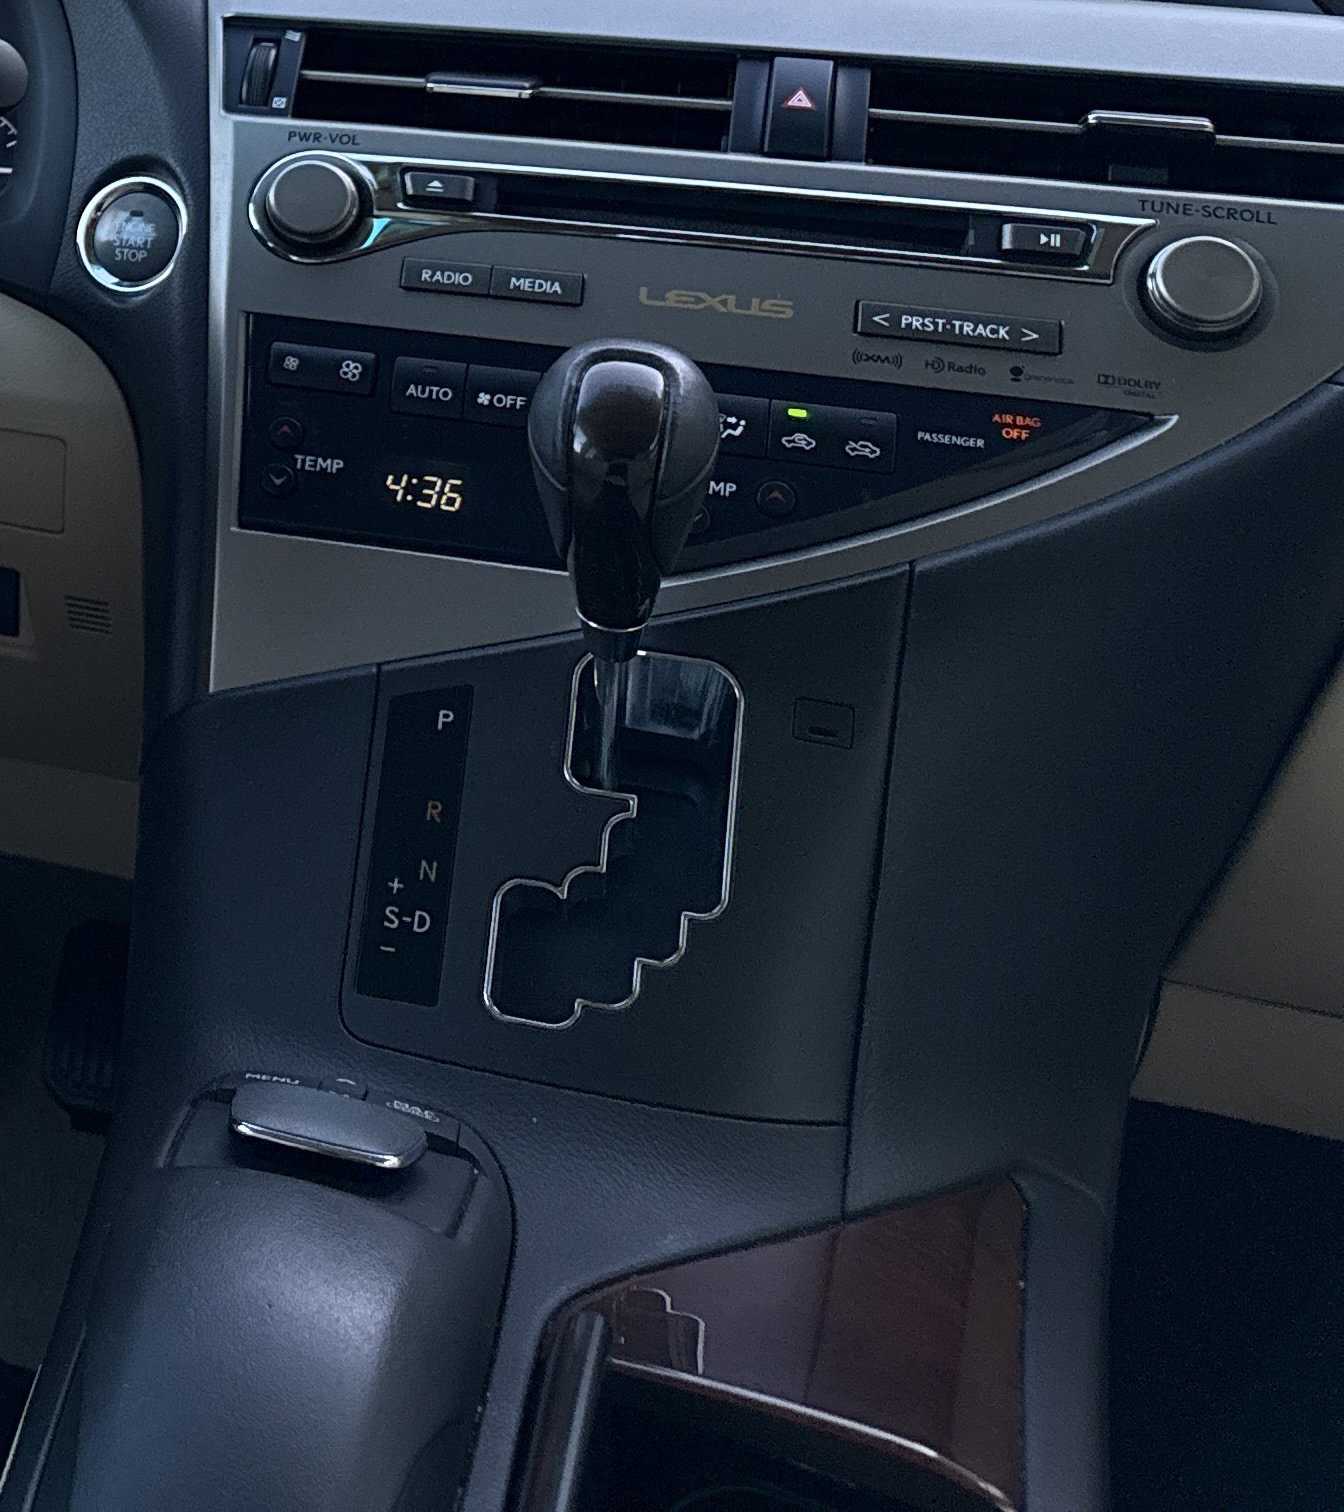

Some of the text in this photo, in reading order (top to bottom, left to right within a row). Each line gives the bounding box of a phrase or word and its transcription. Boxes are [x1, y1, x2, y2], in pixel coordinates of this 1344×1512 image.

[113, 237, 152, 248] START
[114, 248, 148, 263] STOP
[421, 269, 473, 286] RADIO
[509, 276, 562, 295] MEDIA
[639, 286, 794, 319] LEXUS
[948, 361, 987, 377] Radio
[1116, 375, 1162, 391] DOLBY
[405, 384, 528, 410] AUTO OFF
[992, 413, 1042, 428] AIR BAG
[916, 431, 985, 449] PASSENGER
[1002, 428, 1031, 441] OFF
[293, 454, 344, 474] TEMP
[385, 473, 463, 512] 4:36
[437, 709, 454, 731] P
[426, 800, 443, 823] R
[419, 859, 438, 883] N
